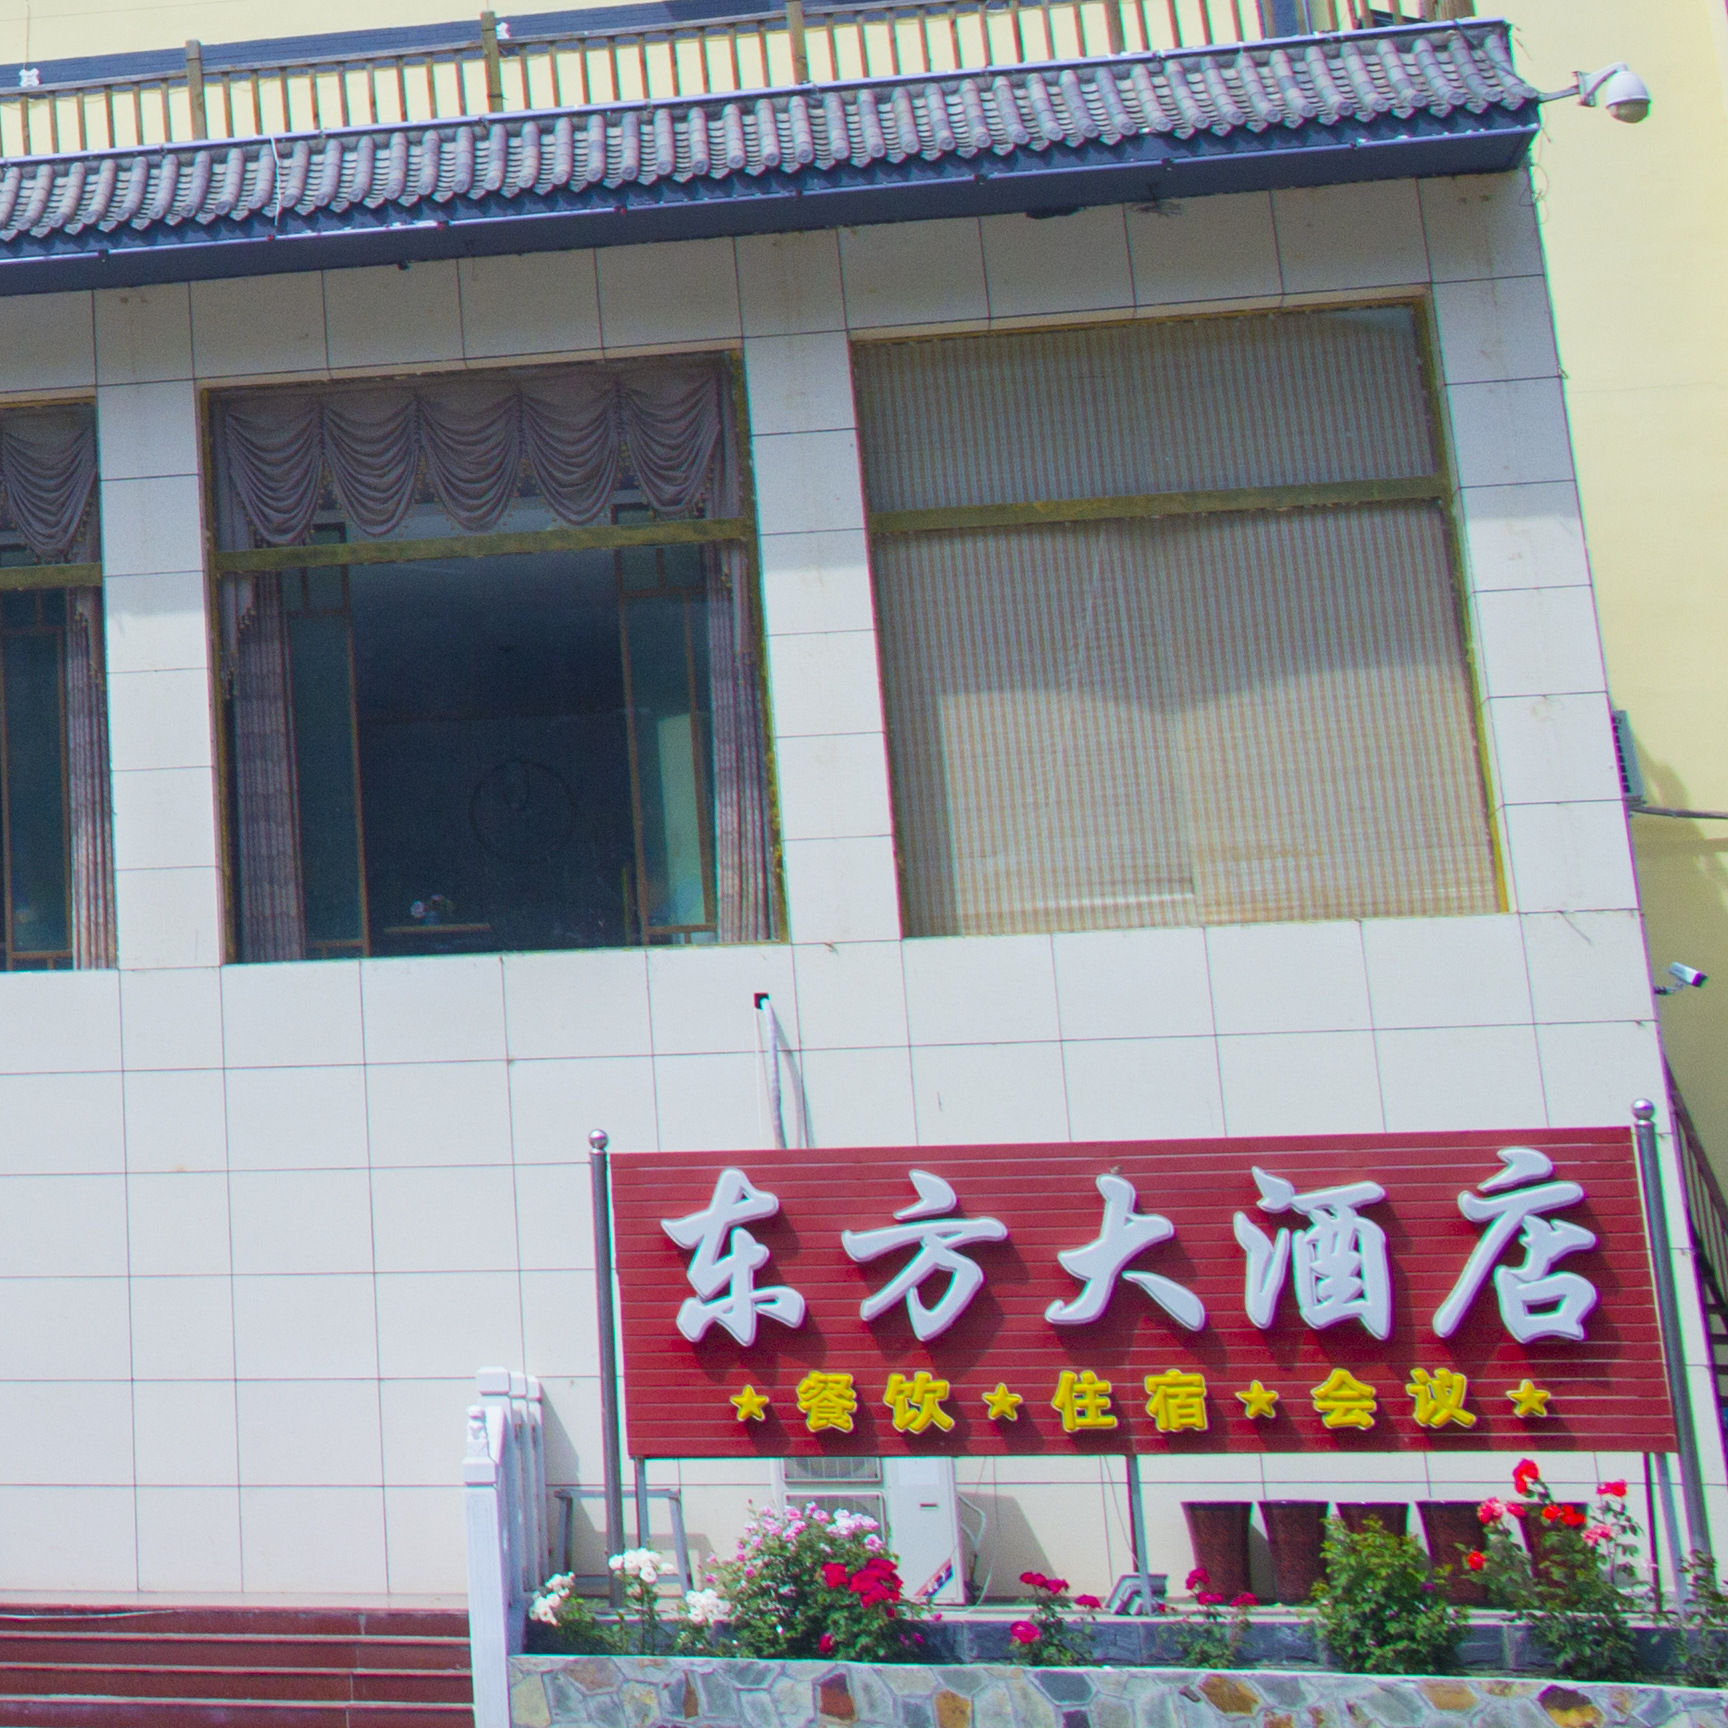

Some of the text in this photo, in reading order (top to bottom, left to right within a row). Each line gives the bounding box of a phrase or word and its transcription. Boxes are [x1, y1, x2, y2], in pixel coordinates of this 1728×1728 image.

[661, 1147, 1599, 1348] 东方大酒店
[795, 1365, 1479, 1436] 餐饮 住宿 会议
